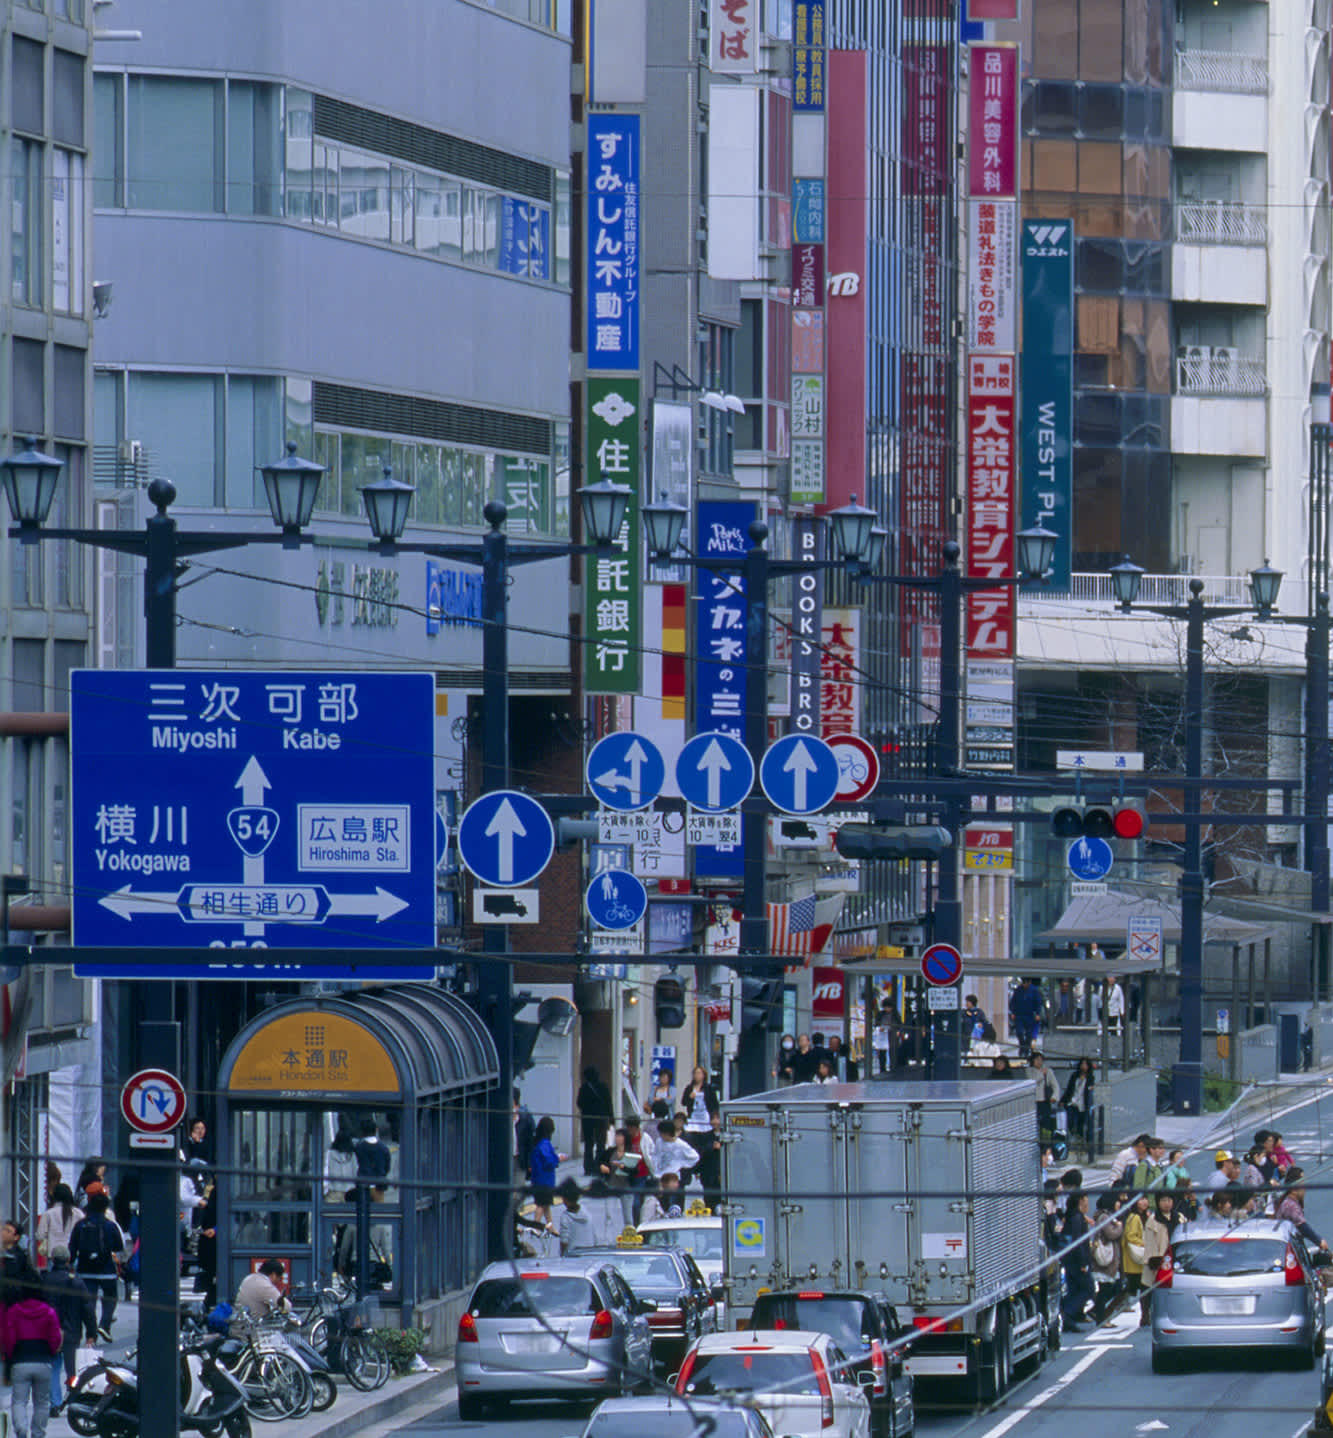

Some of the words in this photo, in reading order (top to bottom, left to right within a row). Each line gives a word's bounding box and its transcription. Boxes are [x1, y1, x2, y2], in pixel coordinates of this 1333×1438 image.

[983, 52, 1002, 193] 品川美容外科
[595, 132, 622, 351] すみしん不動産
[1037, 401, 1056, 481] WEST
[148, 682, 241, 722] 三次
[265, 682, 359, 724] 可部
[151, 729, 237, 752] Miyoshi
[282, 729, 341, 750] Kabe
[95, 804, 189, 846] 横川
[237, 815, 271, 840] 54
[308, 815, 399, 844] 広島駅
[95, 850, 190, 874] Yokogawa
[309, 847, 370, 863] Hiroshima
[376, 847, 400, 862] Sta.
[201, 891, 307, 917] 相生通り
[713, 936, 737, 949] KFC
[813, 983, 842, 1000] JTB
[282, 1048, 348, 1069] 本通駅
[280, 1070, 325, 1080] Hondori
